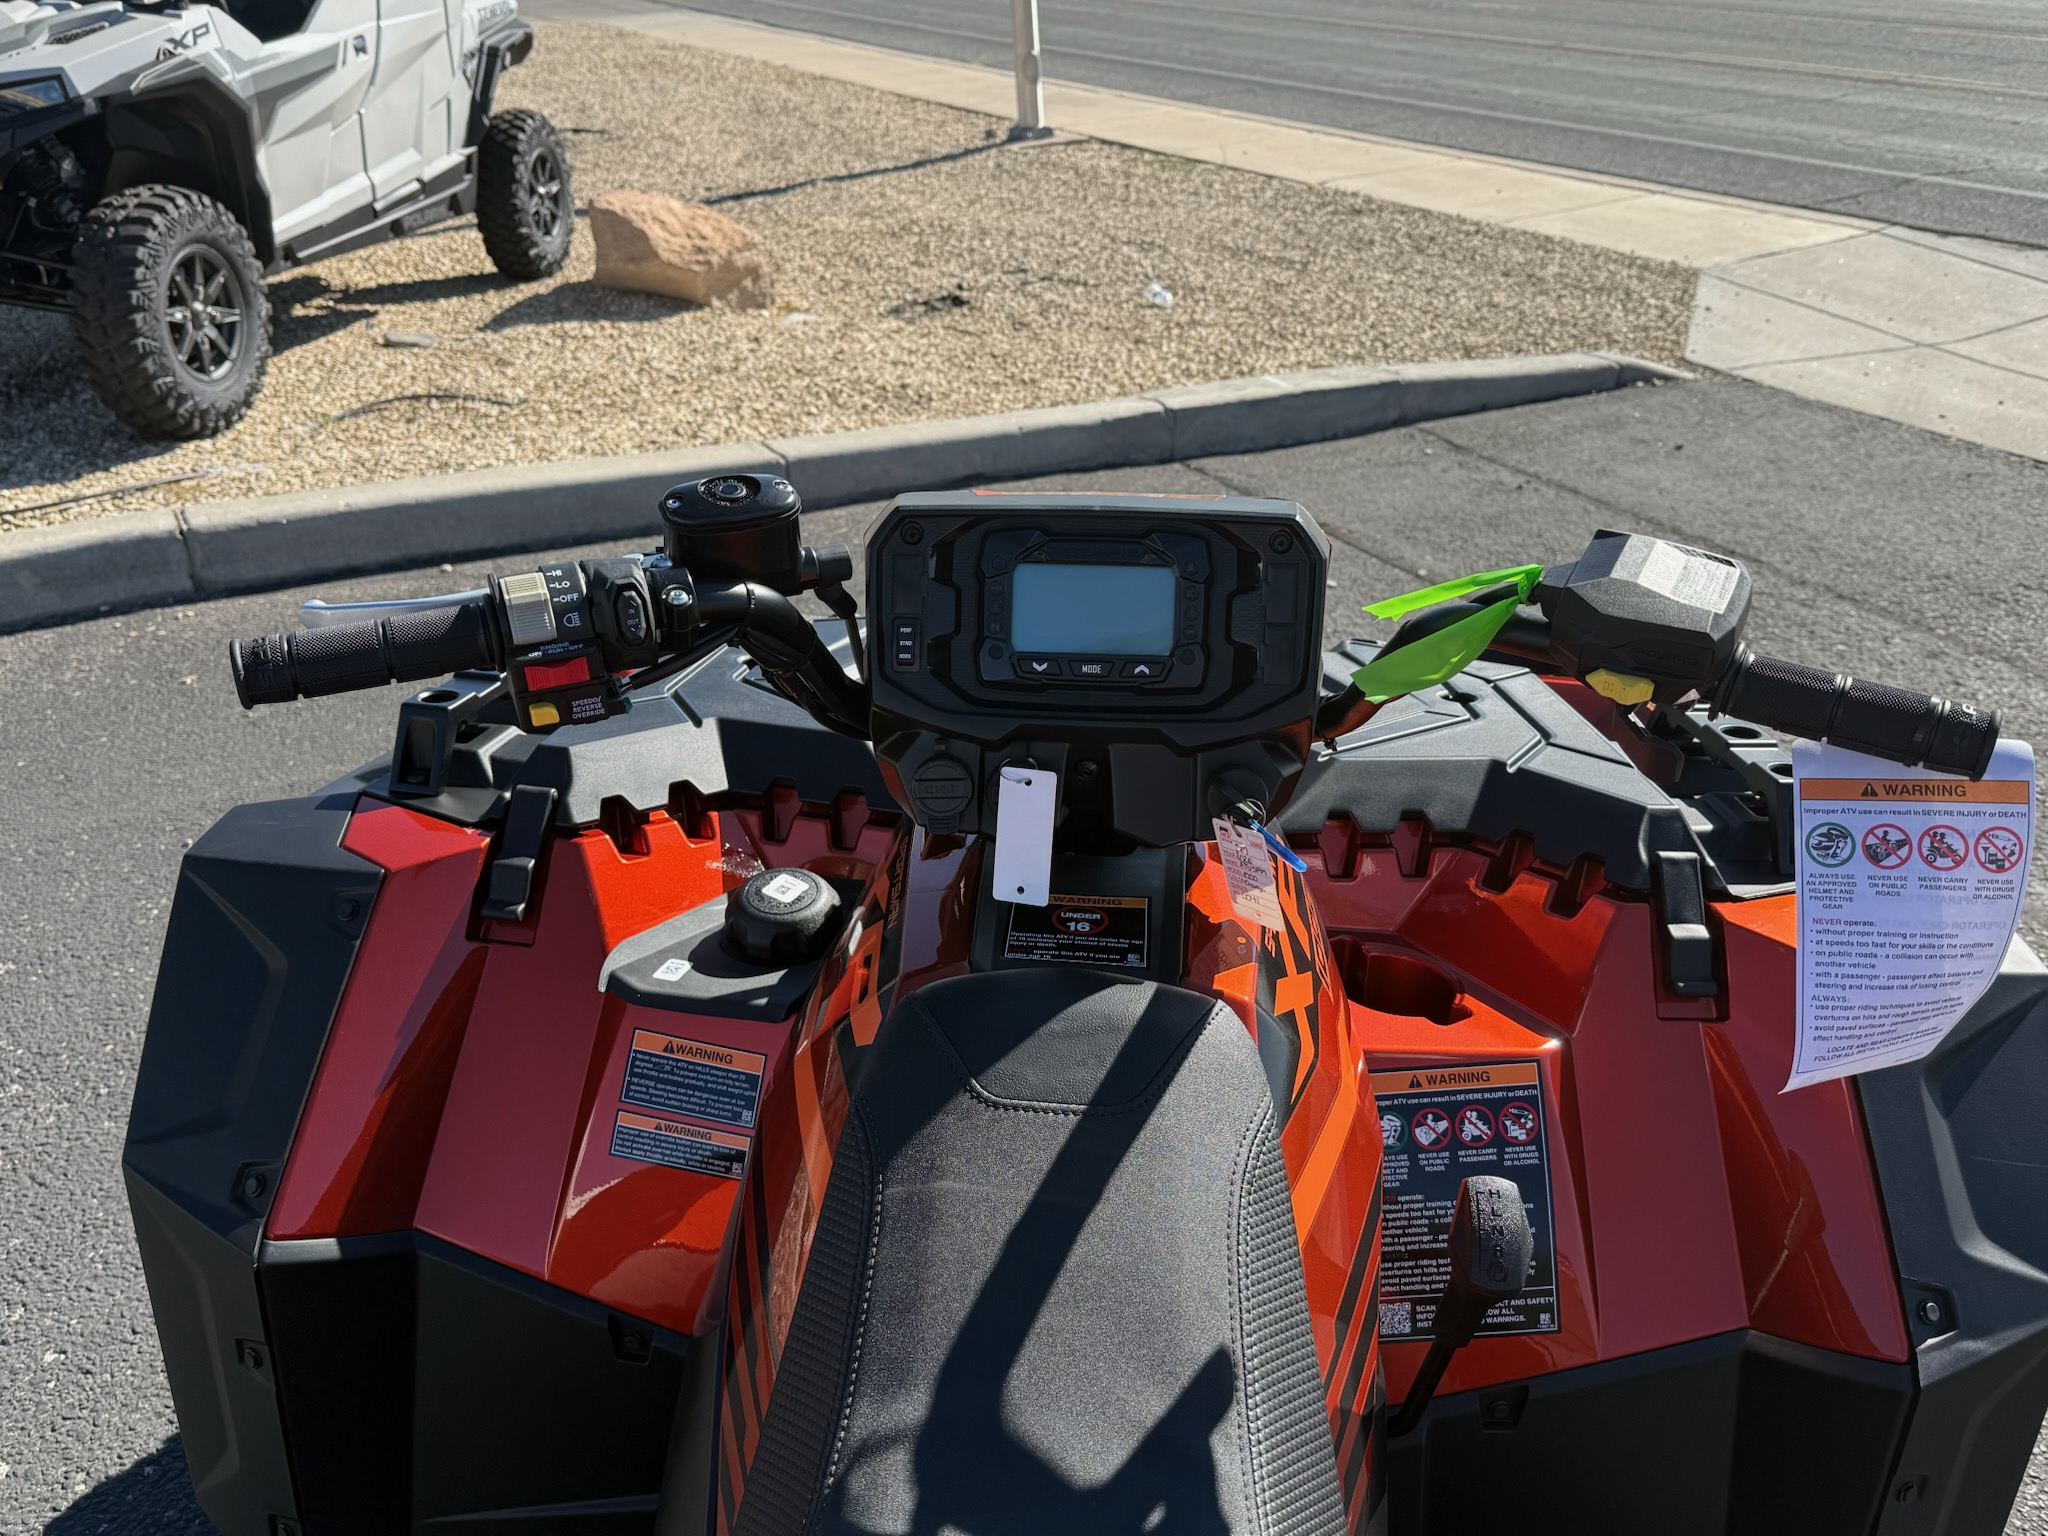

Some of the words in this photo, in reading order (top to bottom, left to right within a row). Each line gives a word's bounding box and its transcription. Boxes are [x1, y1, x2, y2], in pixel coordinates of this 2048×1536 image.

[164, 21, 210, 50] XP
[560, 593, 579, 602] OFF
[540, 642, 570, 650] ENGINE
[1081, 664, 1102, 674] MODE
[573, 702, 602, 712] REVERSE
[572, 708, 606, 719] OVERRIDE
[1883, 784, 1967, 797] WARNING
[1804, 808, 1838, 816] Improper
[1054, 896, 1122, 906] WARNING
[1066, 921, 1090, 931] 16
[1877, 930, 1907, 939] training
[1815, 982, 1846, 991] steering
[1811, 994, 1850, 1003] ALWAYS:
[676, 1044, 733, 1064] WARNING
[1426, 1071, 1490, 1086] WARNING
[1457, 1093, 1482, 1101] SEVERE
[664, 1123, 712, 1141] WARNING
[1486, 1315, 1526, 1323] WARNINGS.
